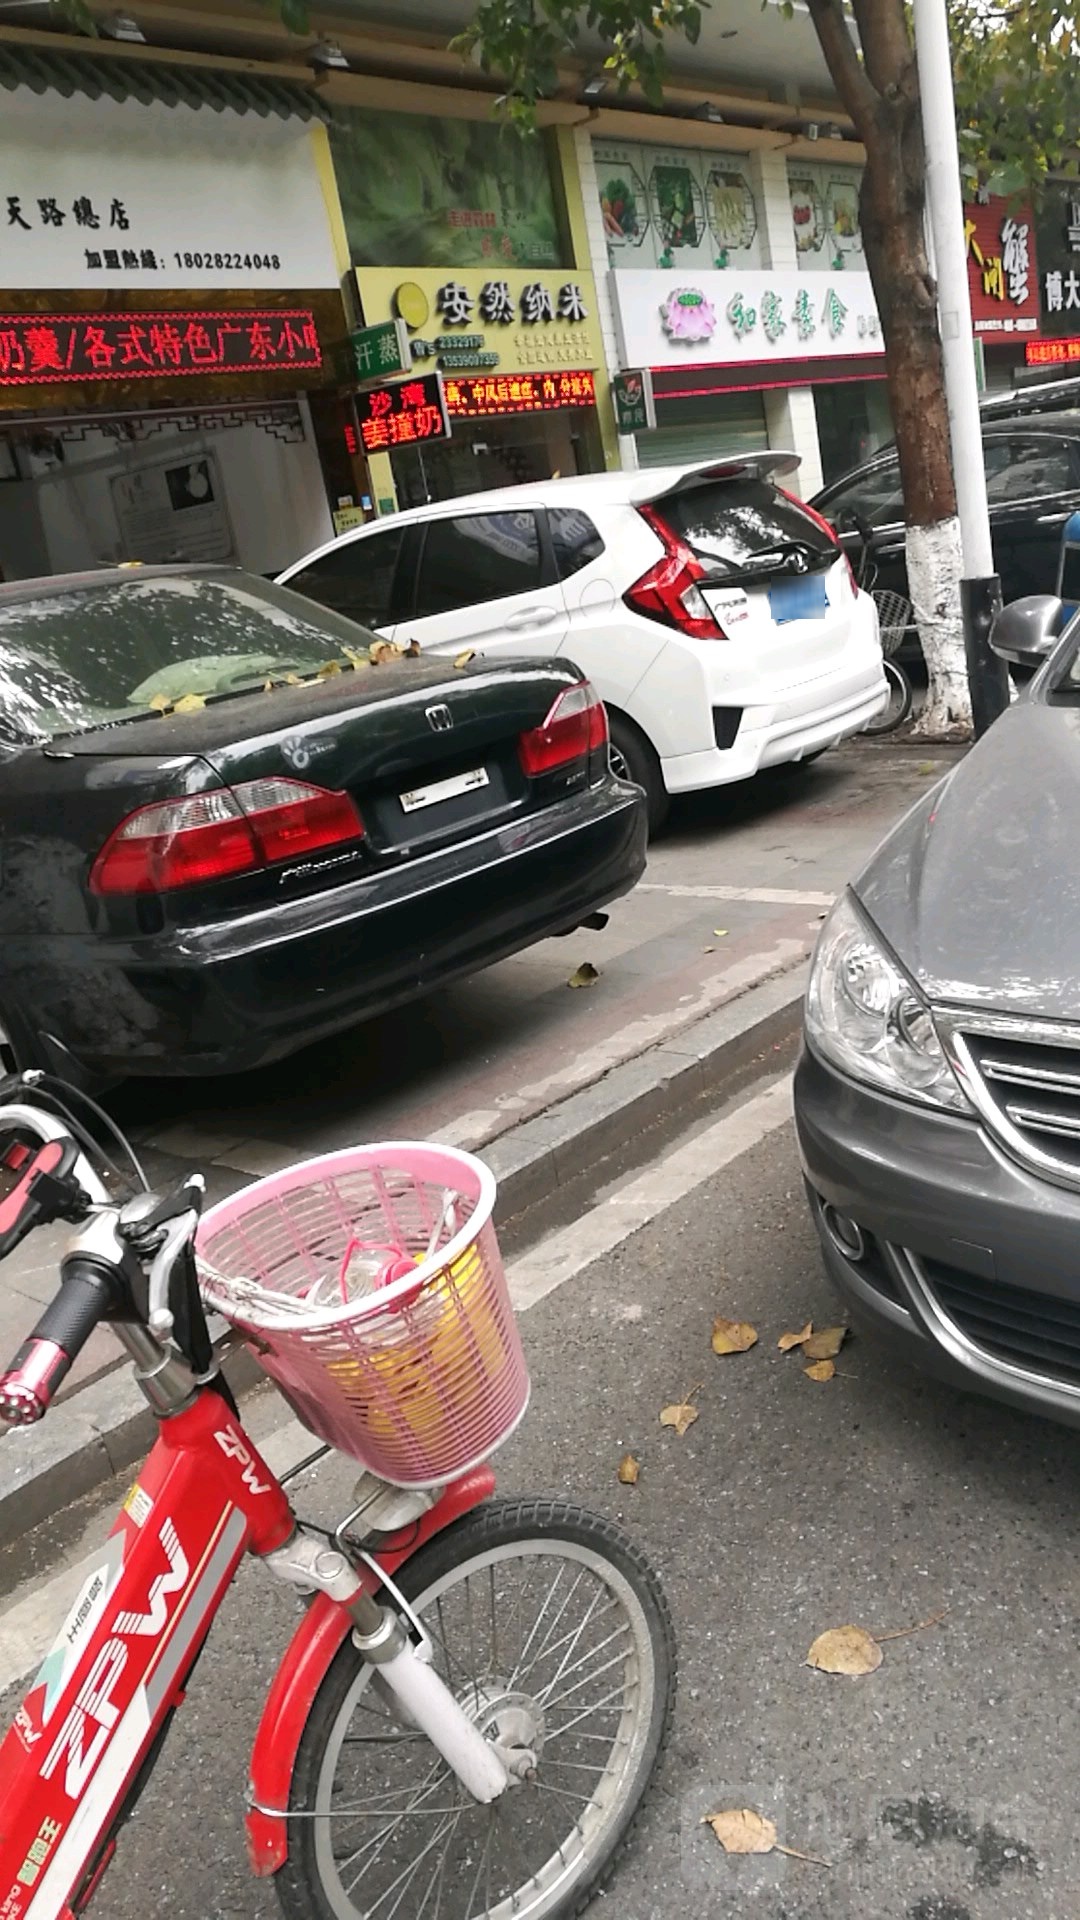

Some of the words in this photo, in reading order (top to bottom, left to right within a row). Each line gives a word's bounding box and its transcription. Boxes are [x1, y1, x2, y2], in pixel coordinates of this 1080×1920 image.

[174, 251, 281, 271] 18028224048
[441, 280, 590, 324] 安然纳米
[354, 333, 399, 371] 汗蒸
[213, 1424, 272, 1495] ZPW
[39, 1517, 190, 1800] ZPW
